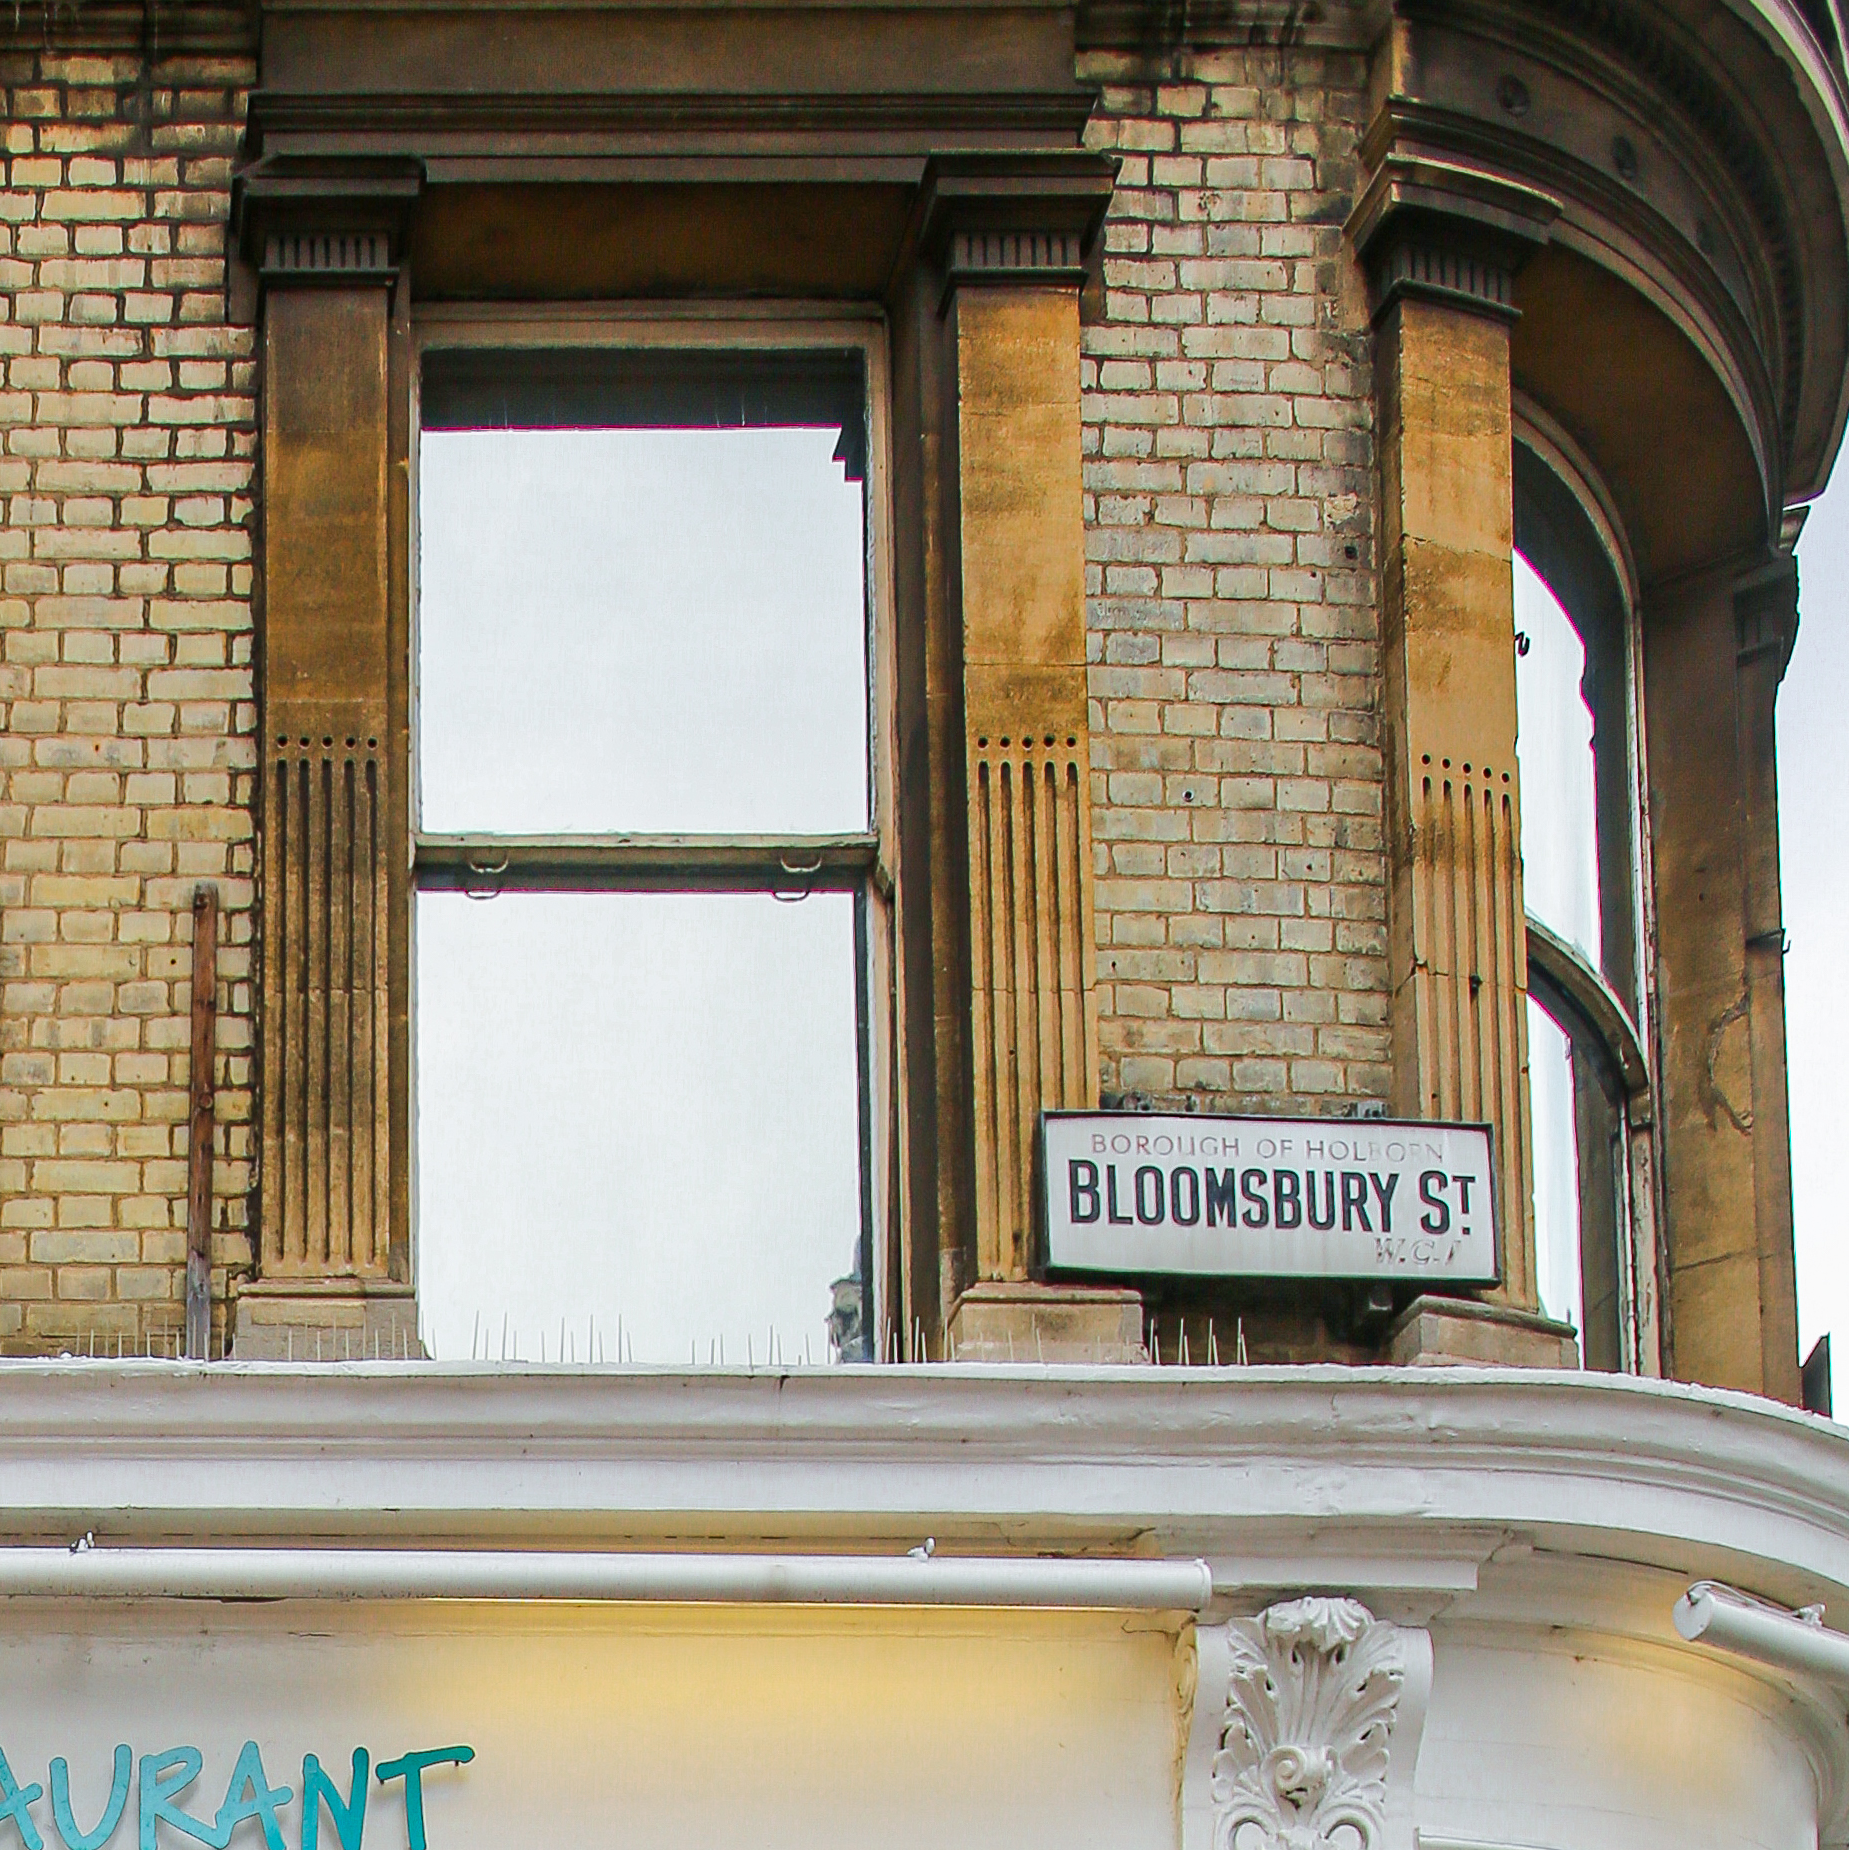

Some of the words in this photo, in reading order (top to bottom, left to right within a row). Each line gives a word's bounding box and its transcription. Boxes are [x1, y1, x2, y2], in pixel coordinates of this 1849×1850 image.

[1092, 1133, 1240, 1158] BOROUGH
[1256, 1138, 1294, 1159] OF
[1068, 1158, 1400, 1233] BLOOMSBURY
